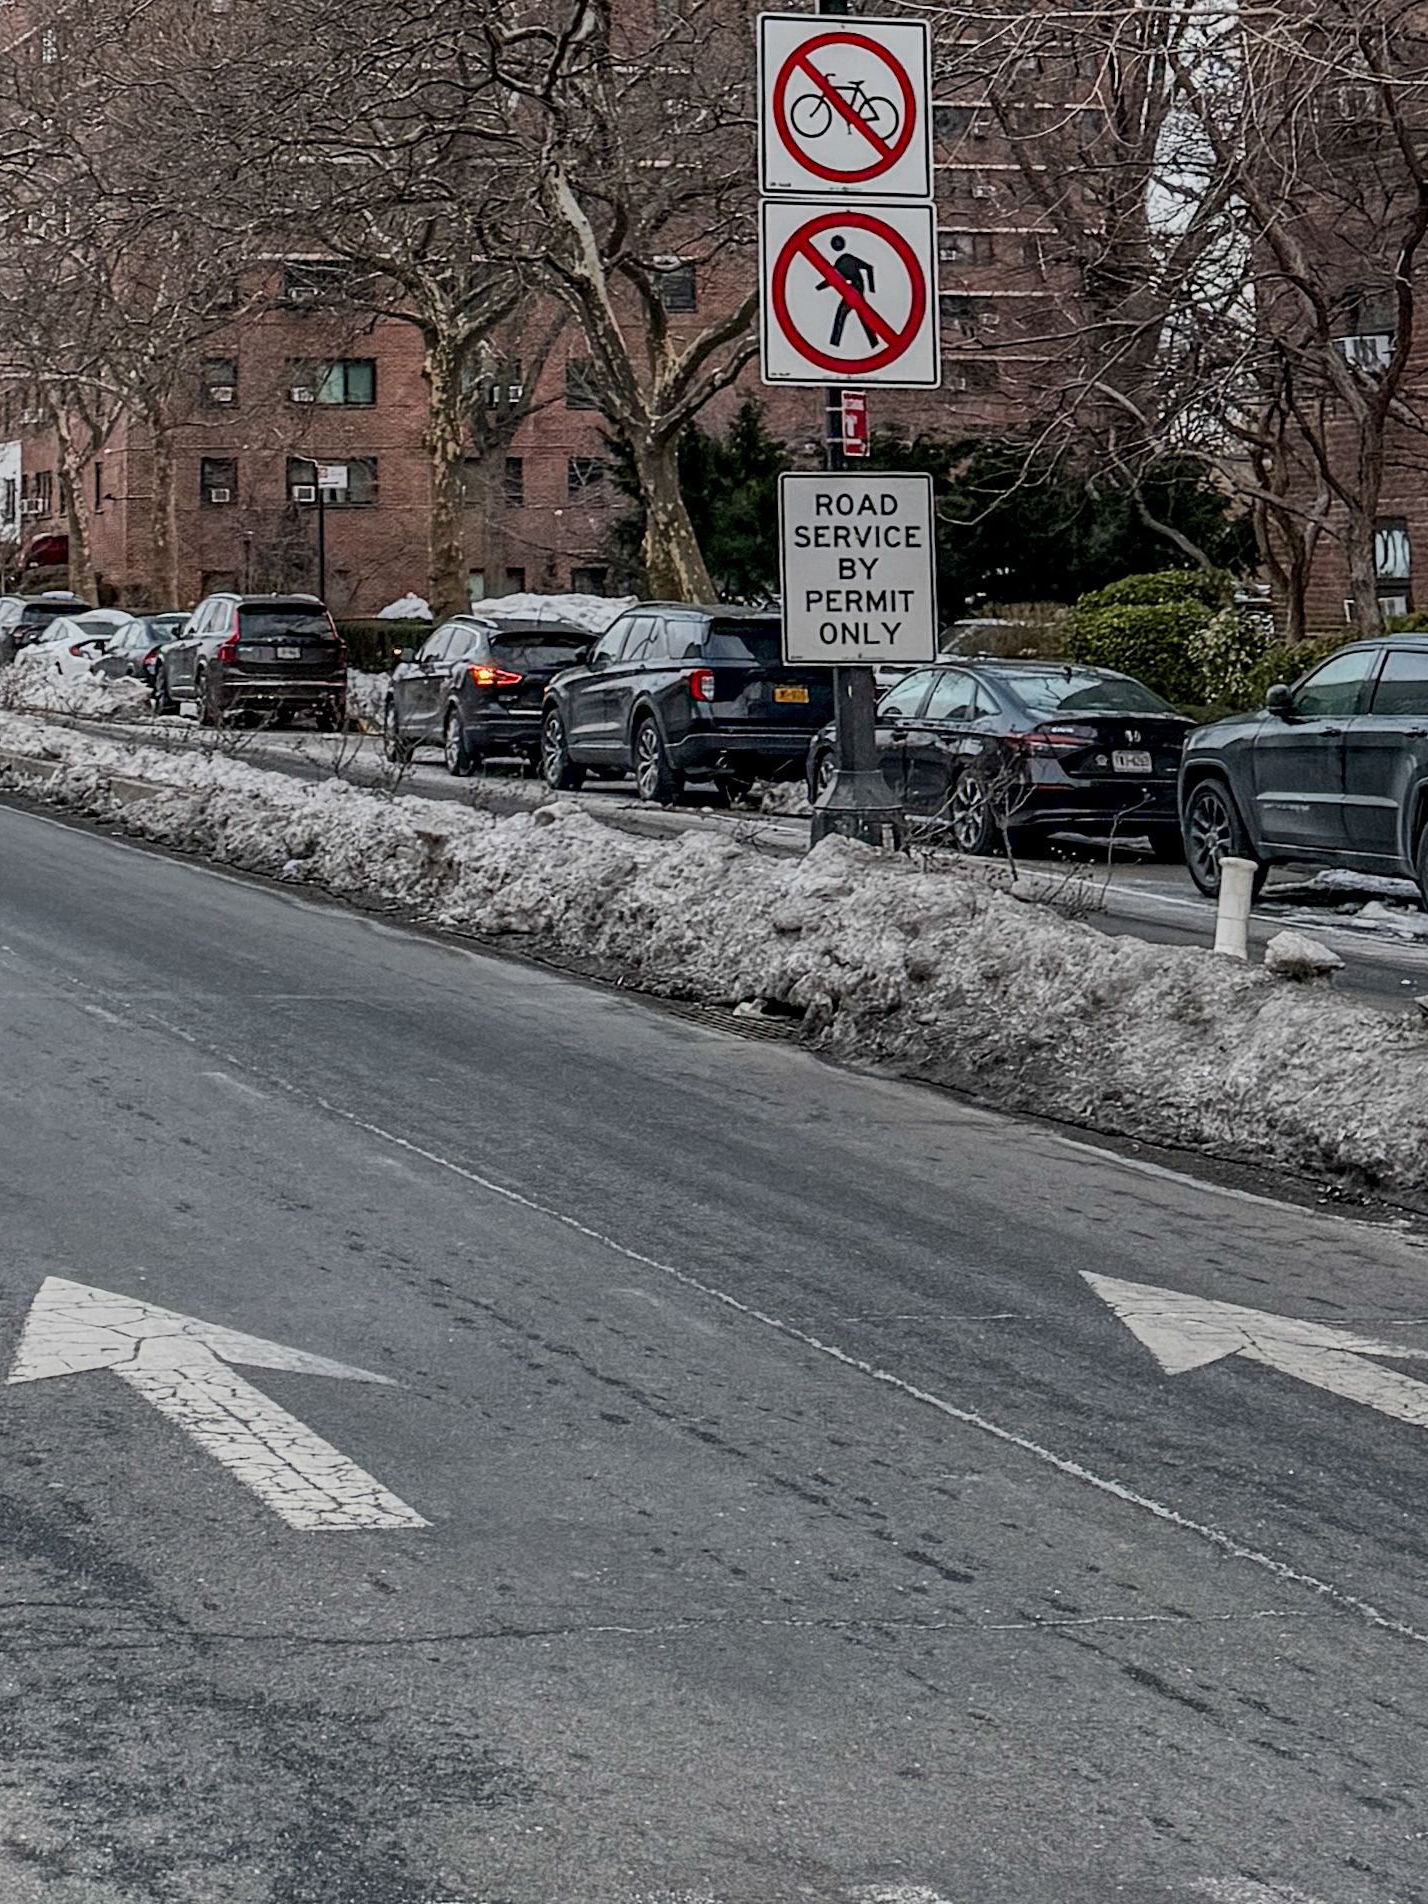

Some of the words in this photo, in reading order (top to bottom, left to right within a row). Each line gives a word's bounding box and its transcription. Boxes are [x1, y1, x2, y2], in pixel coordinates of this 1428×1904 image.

[816, 494, 897, 515] ROAD
[795, 526, 921, 548] SERVICE
[839, 558, 878, 580] BY
[806, 590, 914, 612] PERMIT
[820, 622, 901, 644] ONLY
